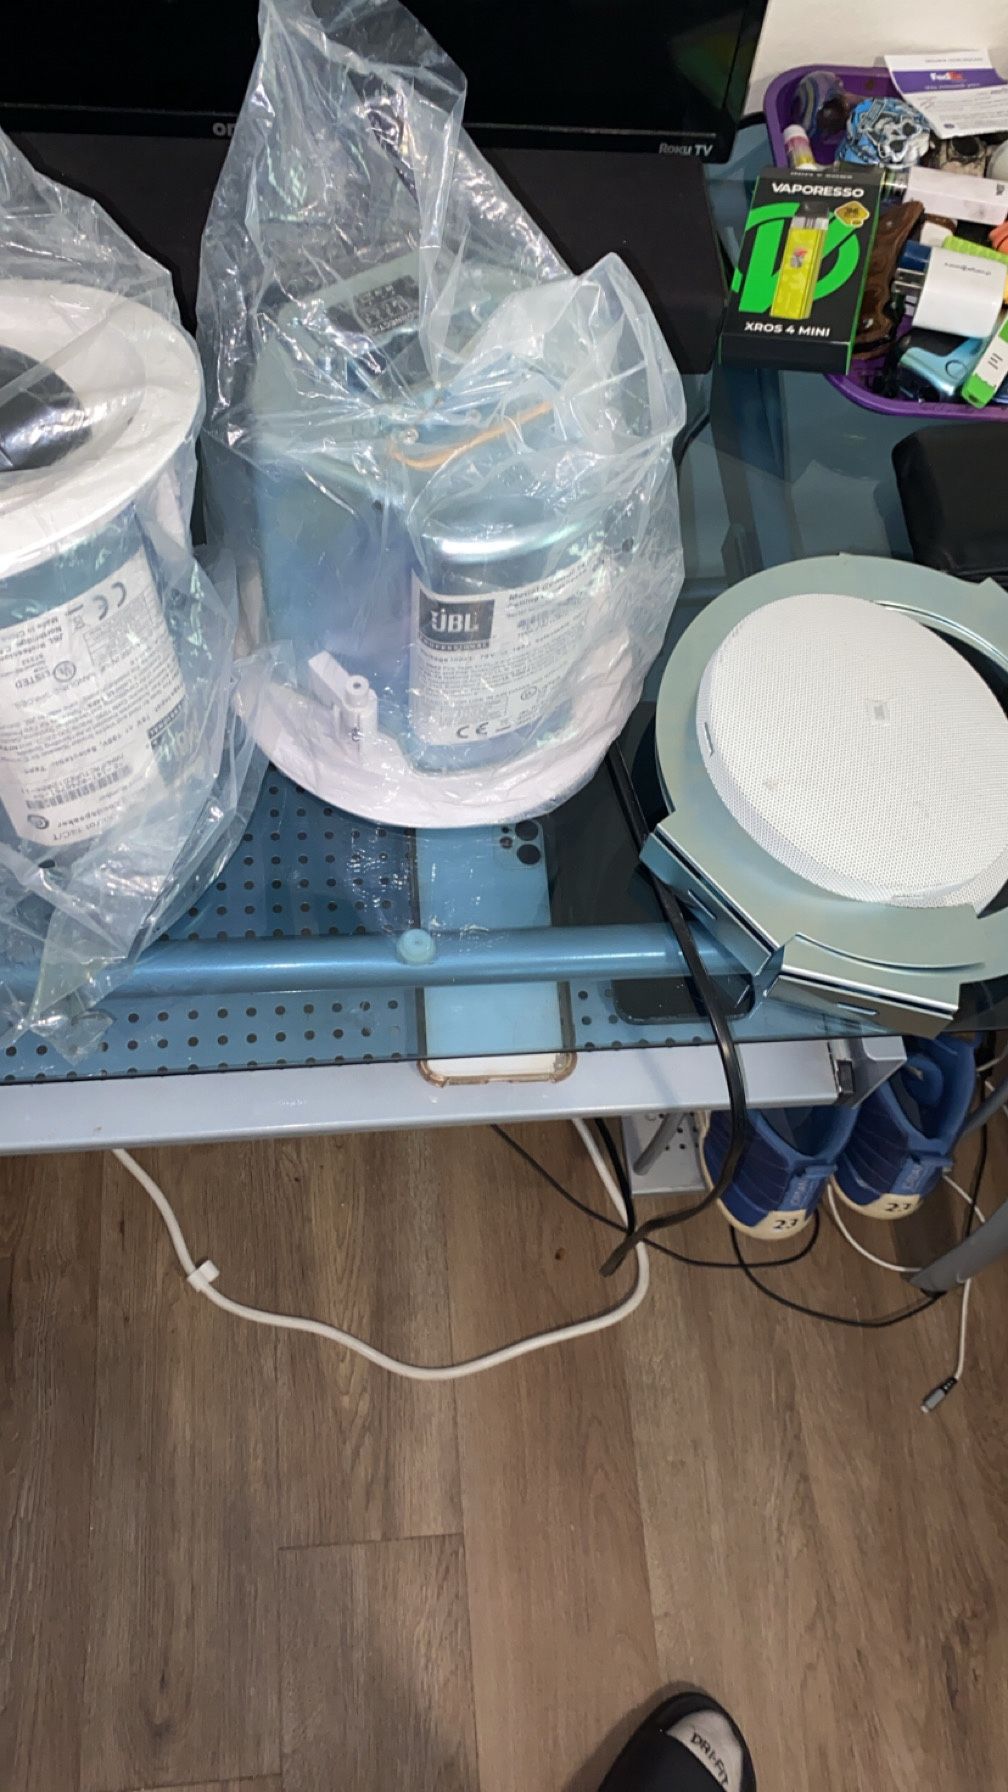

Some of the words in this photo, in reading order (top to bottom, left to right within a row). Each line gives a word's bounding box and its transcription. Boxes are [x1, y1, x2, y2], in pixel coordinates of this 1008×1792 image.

[659, 142, 692, 156] Roku
[694, 143, 714, 157] TV
[771, 182, 864, 198] VAPORESSO
[744, 321, 782, 334] XROS
[784, 324, 796, 334] 4
[798, 323, 831, 338] MINI
[431, 610, 480, 633] JBL
